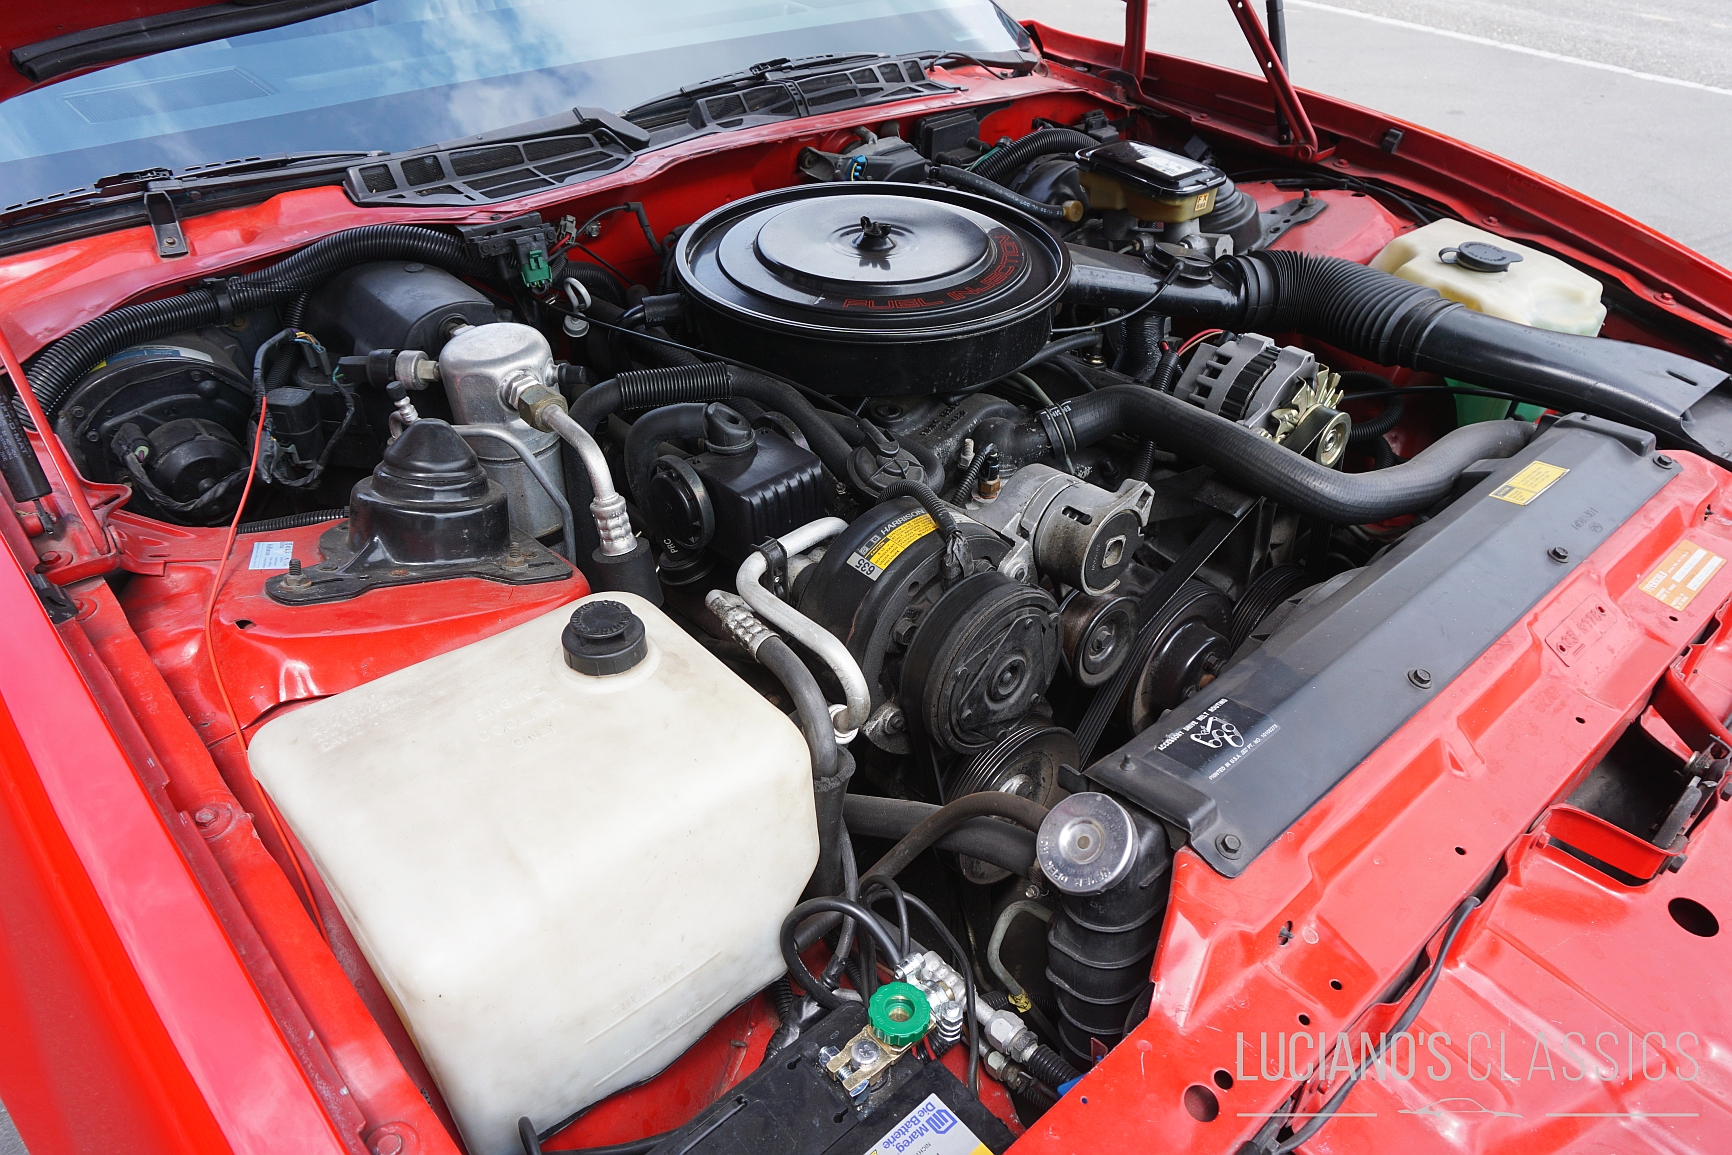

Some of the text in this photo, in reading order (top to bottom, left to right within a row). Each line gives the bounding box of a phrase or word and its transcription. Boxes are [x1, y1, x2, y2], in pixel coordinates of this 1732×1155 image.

[843, 234, 1019, 310] FUEL INJECTION
[881, 509, 925, 535] HARRISON
[663, 538, 678, 554] PRC
[855, 558, 876, 576] 635
[474, 686, 546, 721] ENGINE
[479, 697, 564, 741] COOLANT
[512, 722, 555, 748] ONLY
[1209, 766, 1226, 780] PRINTED
[882, 1101, 936, 1149] Die Batterie
[895, 1123, 930, 1153] Mareg
